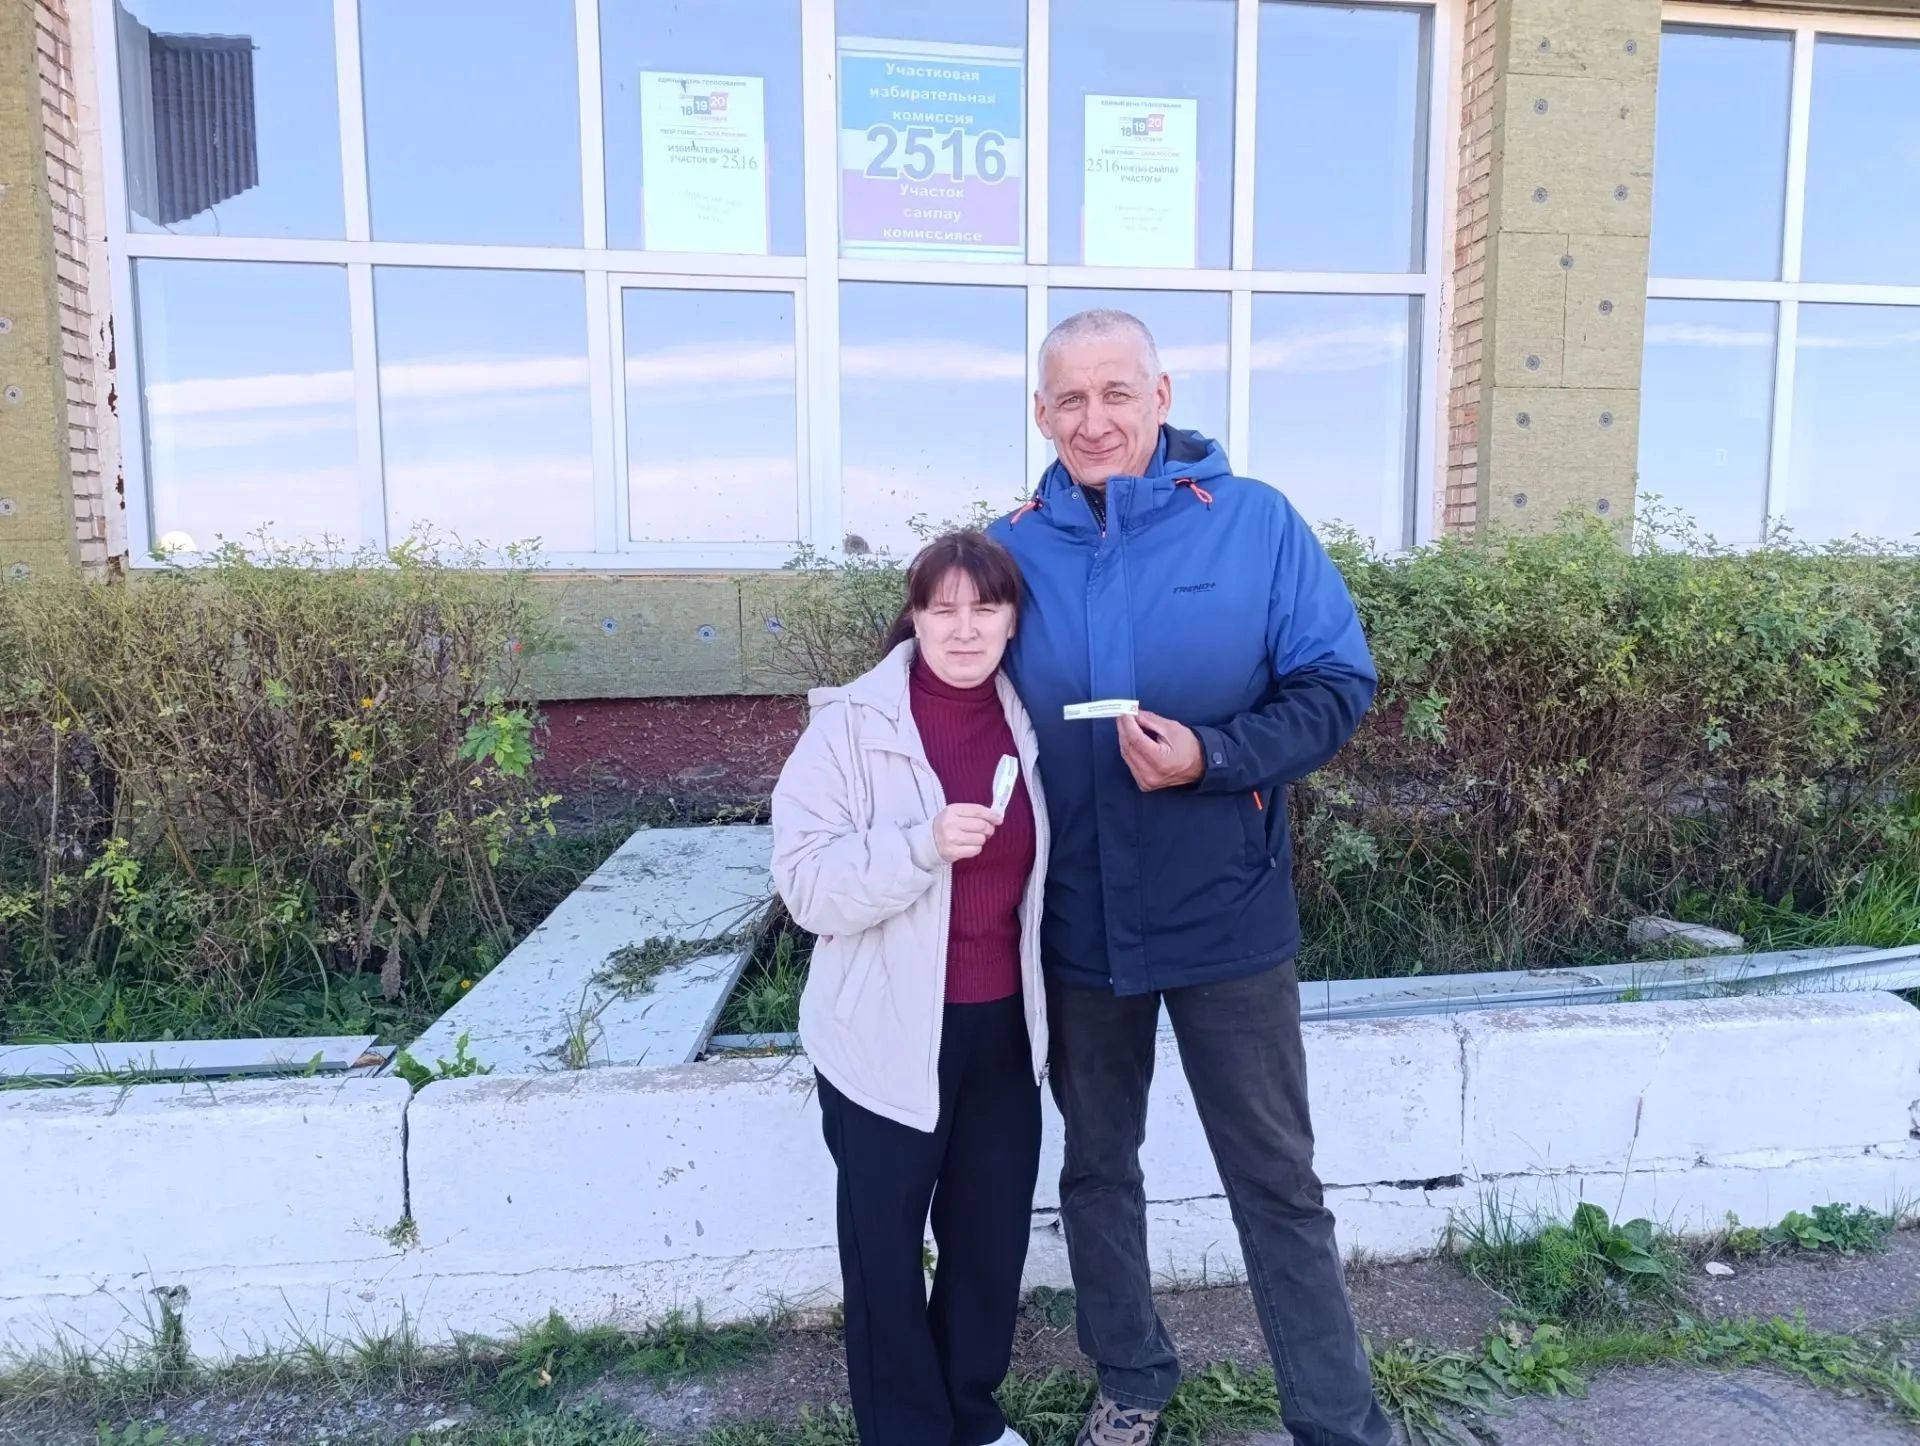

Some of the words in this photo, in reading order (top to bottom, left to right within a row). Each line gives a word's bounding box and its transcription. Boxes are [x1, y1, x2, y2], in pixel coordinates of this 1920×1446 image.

[886, 62, 980, 81] Участковая
[710, 96, 726, 107] 20
[869, 86, 996, 105] избирательная
[680, 105, 693, 116] 18
[694, 100, 708, 111] 19
[892, 110, 974, 125] комиссия
[1148, 118, 1162, 128] 20
[1120, 127, 1132, 137] 18
[1133, 121, 1146, 132] 19
[667, 144, 740, 154] ИЗБИРАТЕЛЬНЫЙ
[864, 123, 1007, 186] 2516
[670, 154, 708, 164] УЧАСТОК
[720, 154, 758, 170] 2516
[1086, 157, 1120, 174] 2516
[899, 183, 965, 198] Участок
[883, 228, 983, 242] комиссиясе
